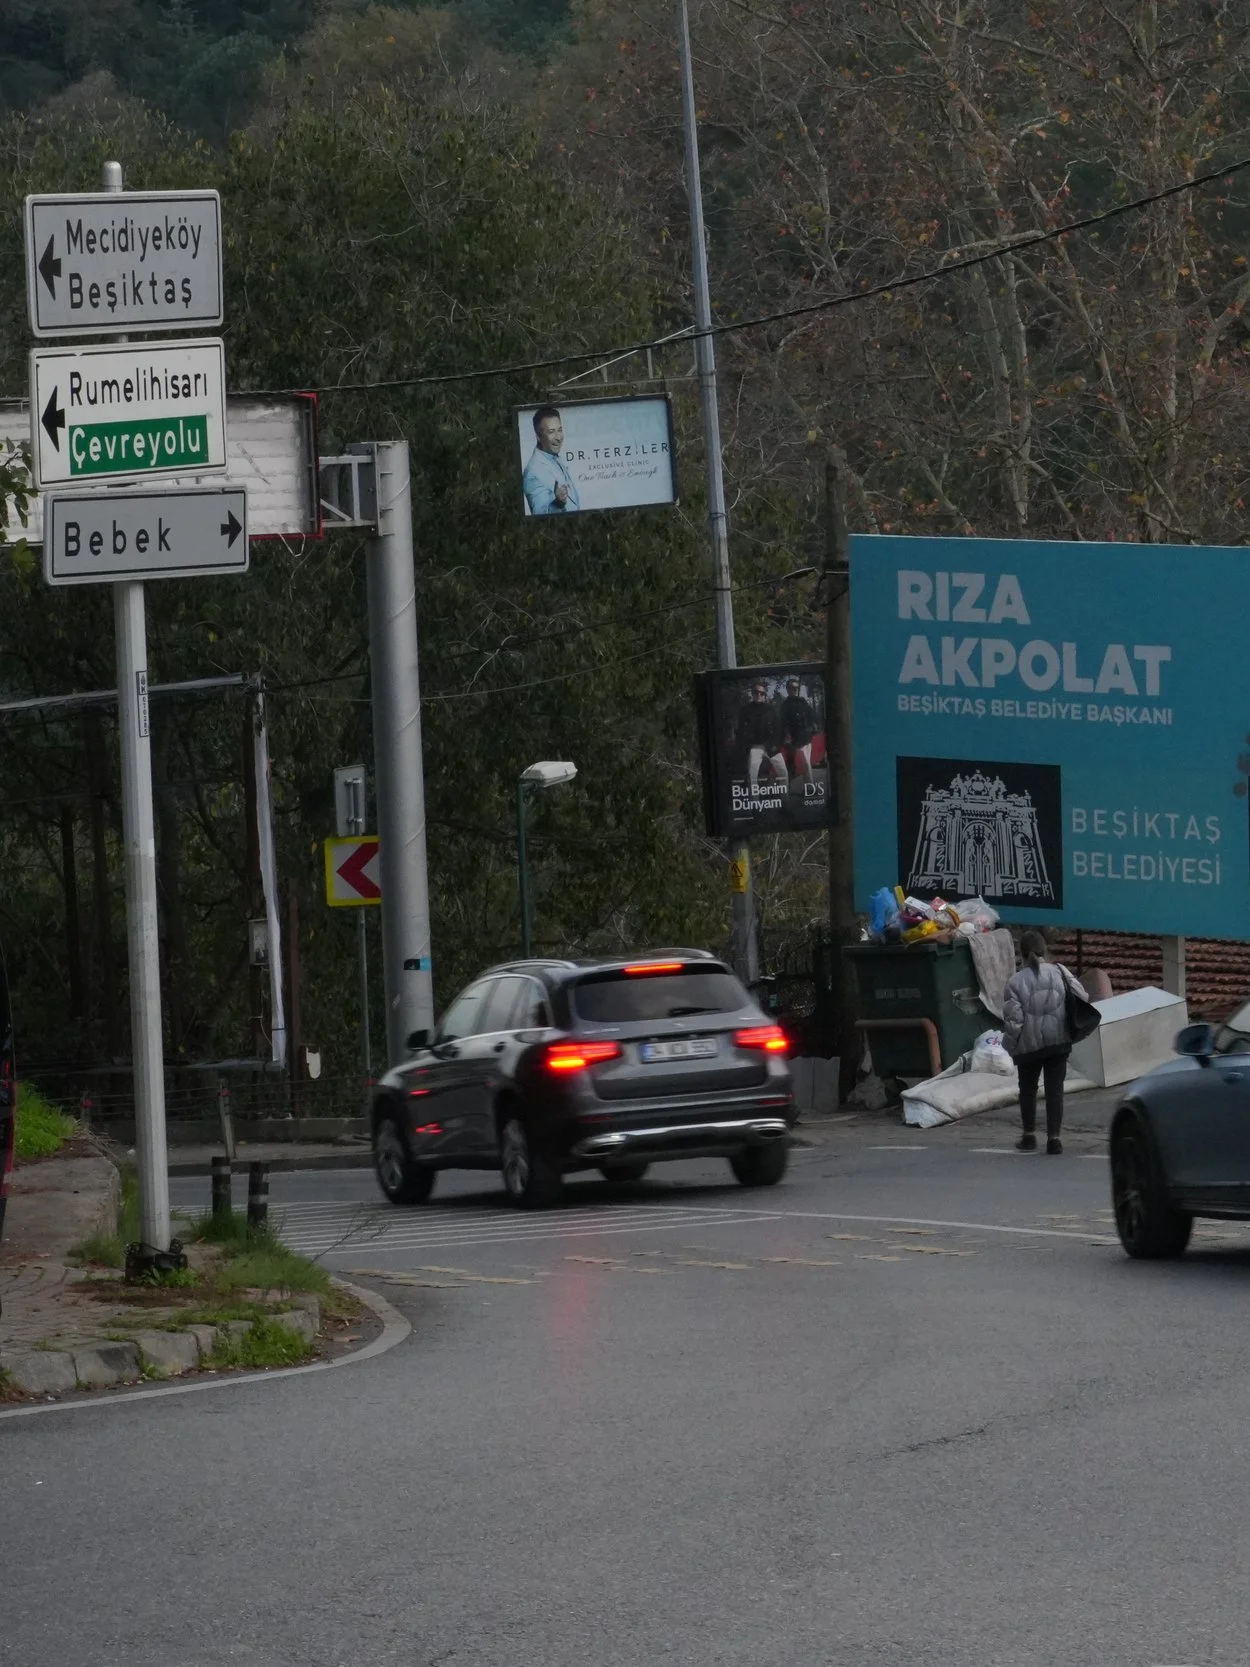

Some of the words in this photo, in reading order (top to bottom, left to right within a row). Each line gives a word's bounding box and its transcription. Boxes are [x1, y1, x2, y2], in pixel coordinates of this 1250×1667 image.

[66, 215, 202, 261] Mecidiyeköy
[68, 271, 193, 313] Beşiktaş
[69, 367, 208, 407] Rumelihisarı
[71, 420, 201, 469] Çevreyolu
[64, 518, 172, 557] Bebek
[896, 570, 1032, 625] RIZA
[898, 634, 1172, 696] AKPOLAT
[897, 691, 986, 719] BEŞİKTAŞ
[991, 698, 1082, 721] BELEDİYE
[1086, 705, 1173, 726] BAŞKANI
[732, 785, 749, 797] Bu
[751, 782, 788, 796] Benim
[733, 797, 782, 812] Dünyam
[1072, 805, 1222, 845] BEŞİKTAŞ
[1072, 850, 1222, 885] BELEDİYESİ
